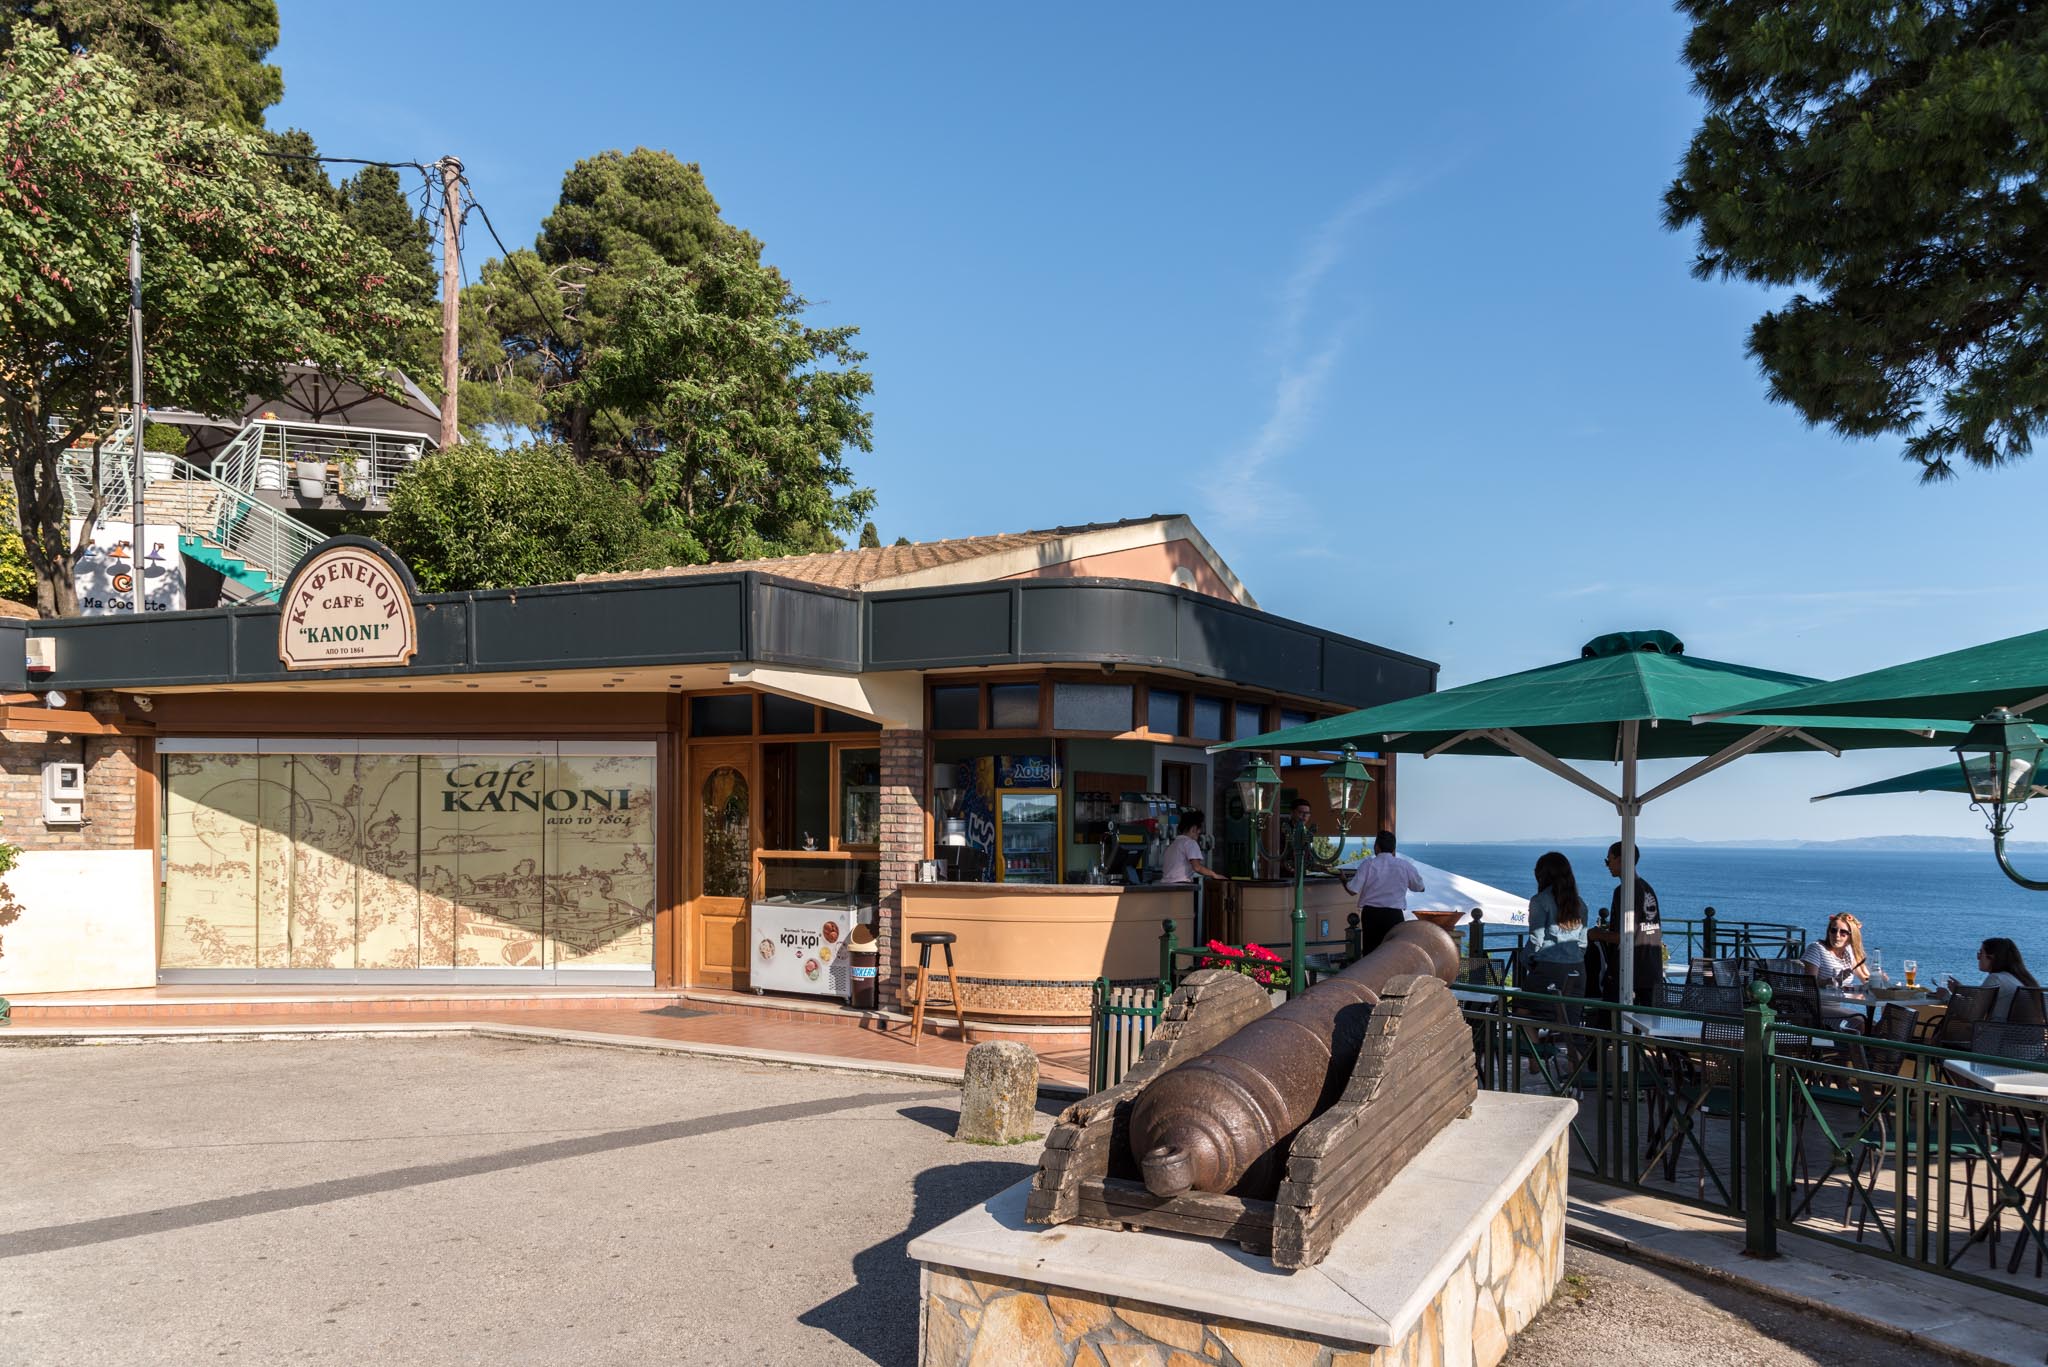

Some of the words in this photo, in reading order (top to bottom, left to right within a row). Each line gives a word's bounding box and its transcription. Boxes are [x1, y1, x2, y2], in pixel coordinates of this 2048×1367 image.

[292, 562, 399, 625] ΚΑΦΕΝΕΙΟΝ
[83, 597, 103, 609] Ma
[108, 598, 167, 611] Coctte
[322, 594, 364, 610] CAFÉ
[350, 646, 364, 654] 1864
[445, 760, 535, 801] Café
[441, 789, 632, 812] KANONI
[598, 814, 632, 827] 1864
